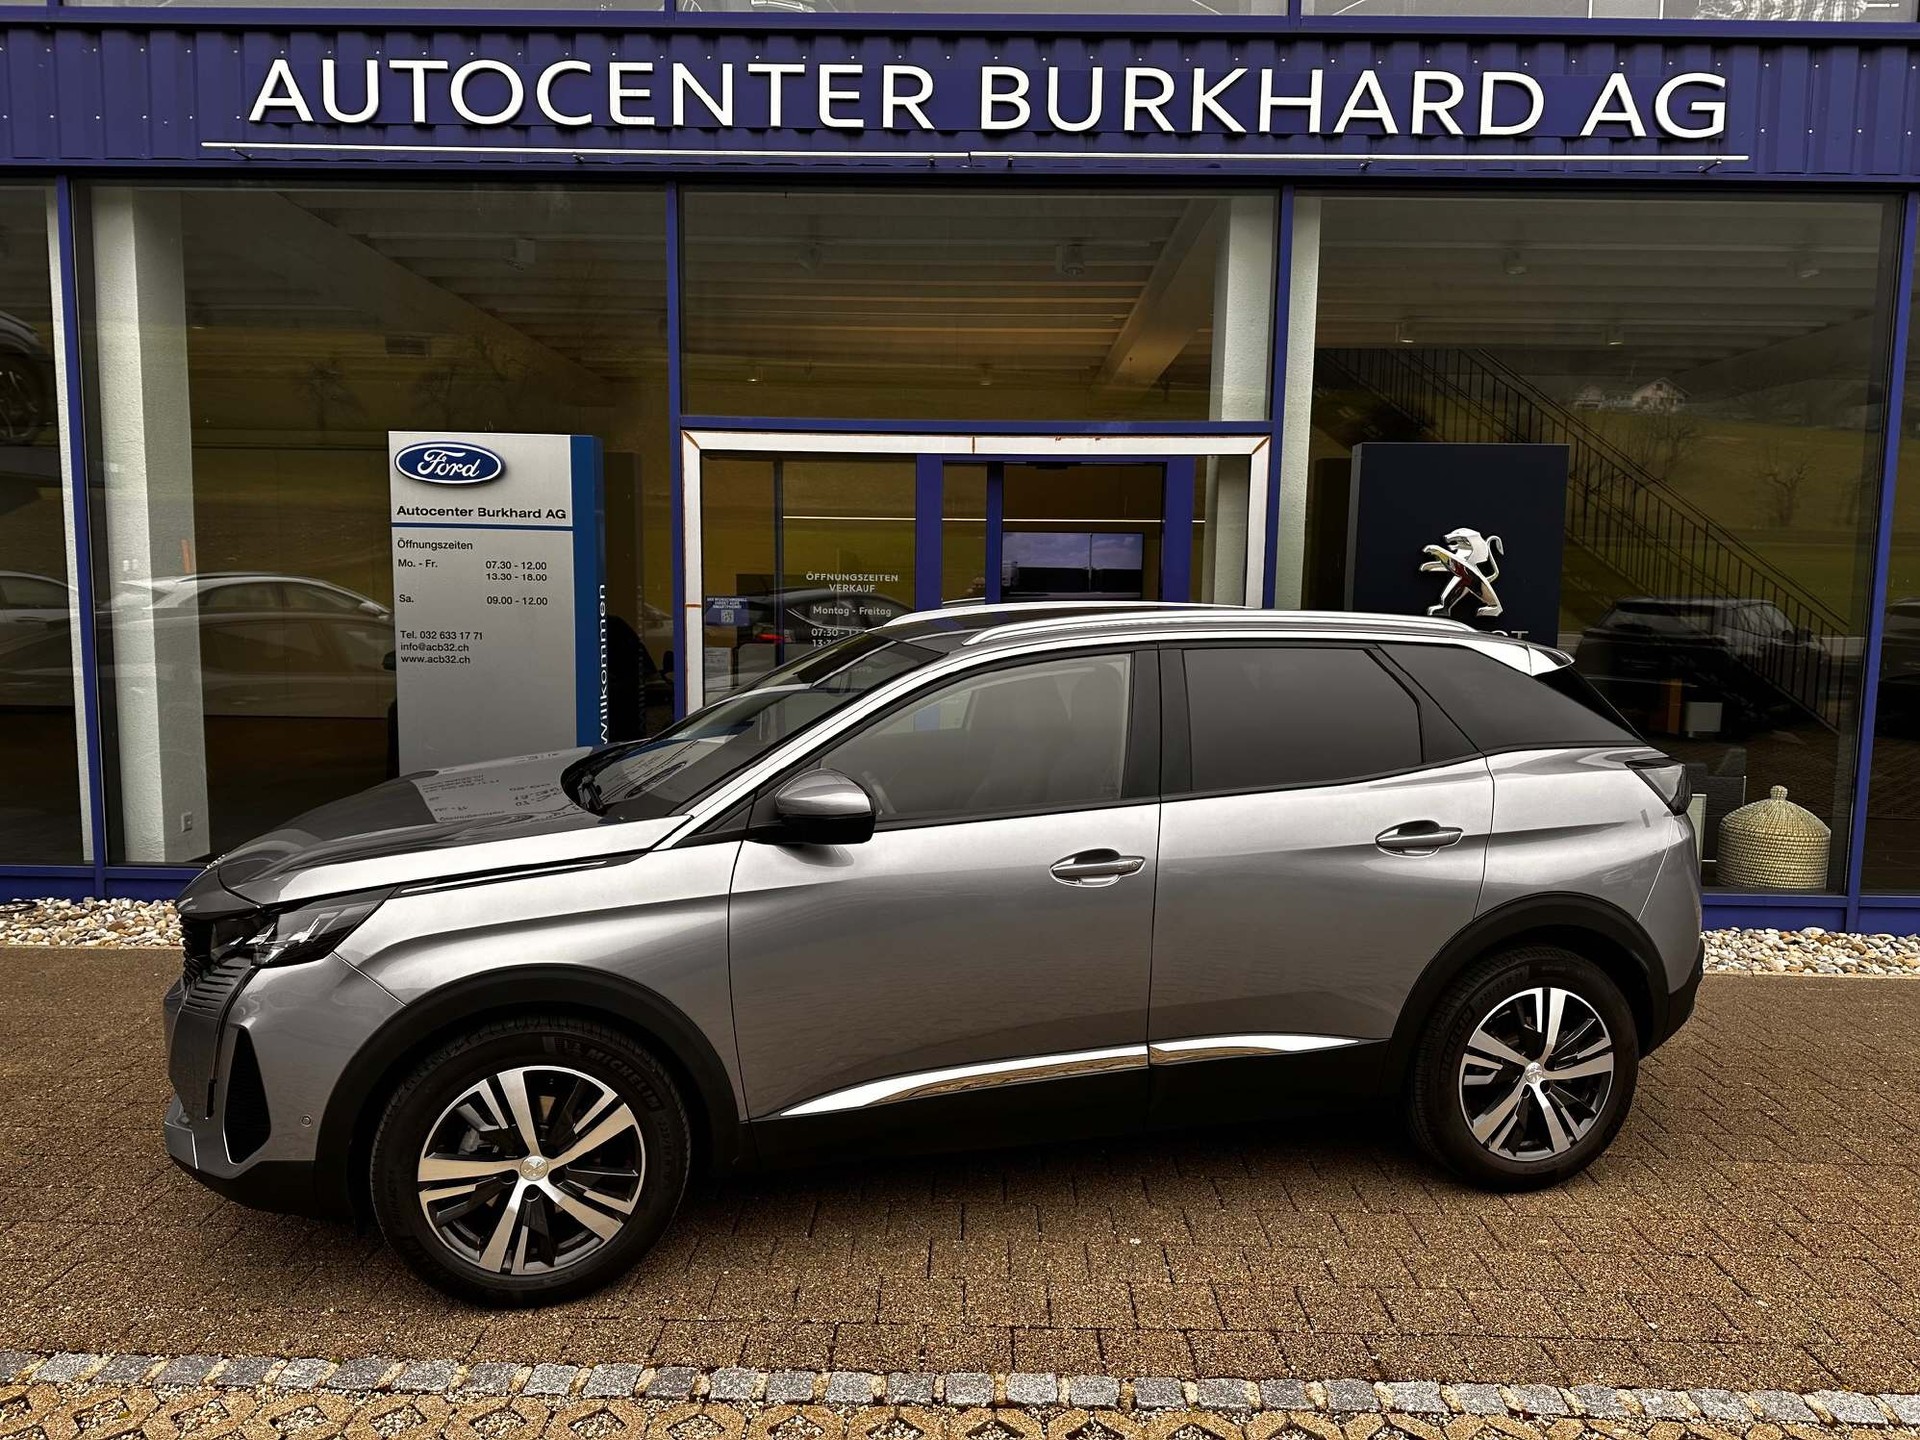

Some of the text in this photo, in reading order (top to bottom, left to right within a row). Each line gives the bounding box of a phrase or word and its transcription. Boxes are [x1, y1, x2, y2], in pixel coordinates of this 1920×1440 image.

[248, 58, 1727, 140] AUTOCENTER BURKHARD AG
[417, 449, 480, 478] Ford
[396, 505, 567, 520] Autocenter Burkhard AG
[397, 537, 473, 551] Öffnungszeiten
[397, 558, 416, 568] Mo.
[425, 559, 438, 568] Fr.
[485, 560, 512, 570] 07.30
[520, 561, 547, 571] 12.00
[485, 572, 512, 582] 13.30
[521, 573, 548, 583] 18.00
[805, 572, 899, 582] ÖFFNUNGSZEITEN
[828, 583, 876, 593] VERKAUF
[398, 593, 415, 603] Sa.
[486, 595, 513, 605] 09.00
[521, 596, 548, 606] 12.00
[812, 606, 850, 617] Montag
[858, 606, 892, 617] Freitag
[399, 630, 483, 641] Tel. 032 633 17 71
[811, 628, 839, 638] 07:30
[400, 642, 470, 652] info@acb32.ch
[812, 639, 836, 648] 13:3
[400, 654, 471, 665] www.acb32.ch
[599, 584, 608, 745] Willkommen
